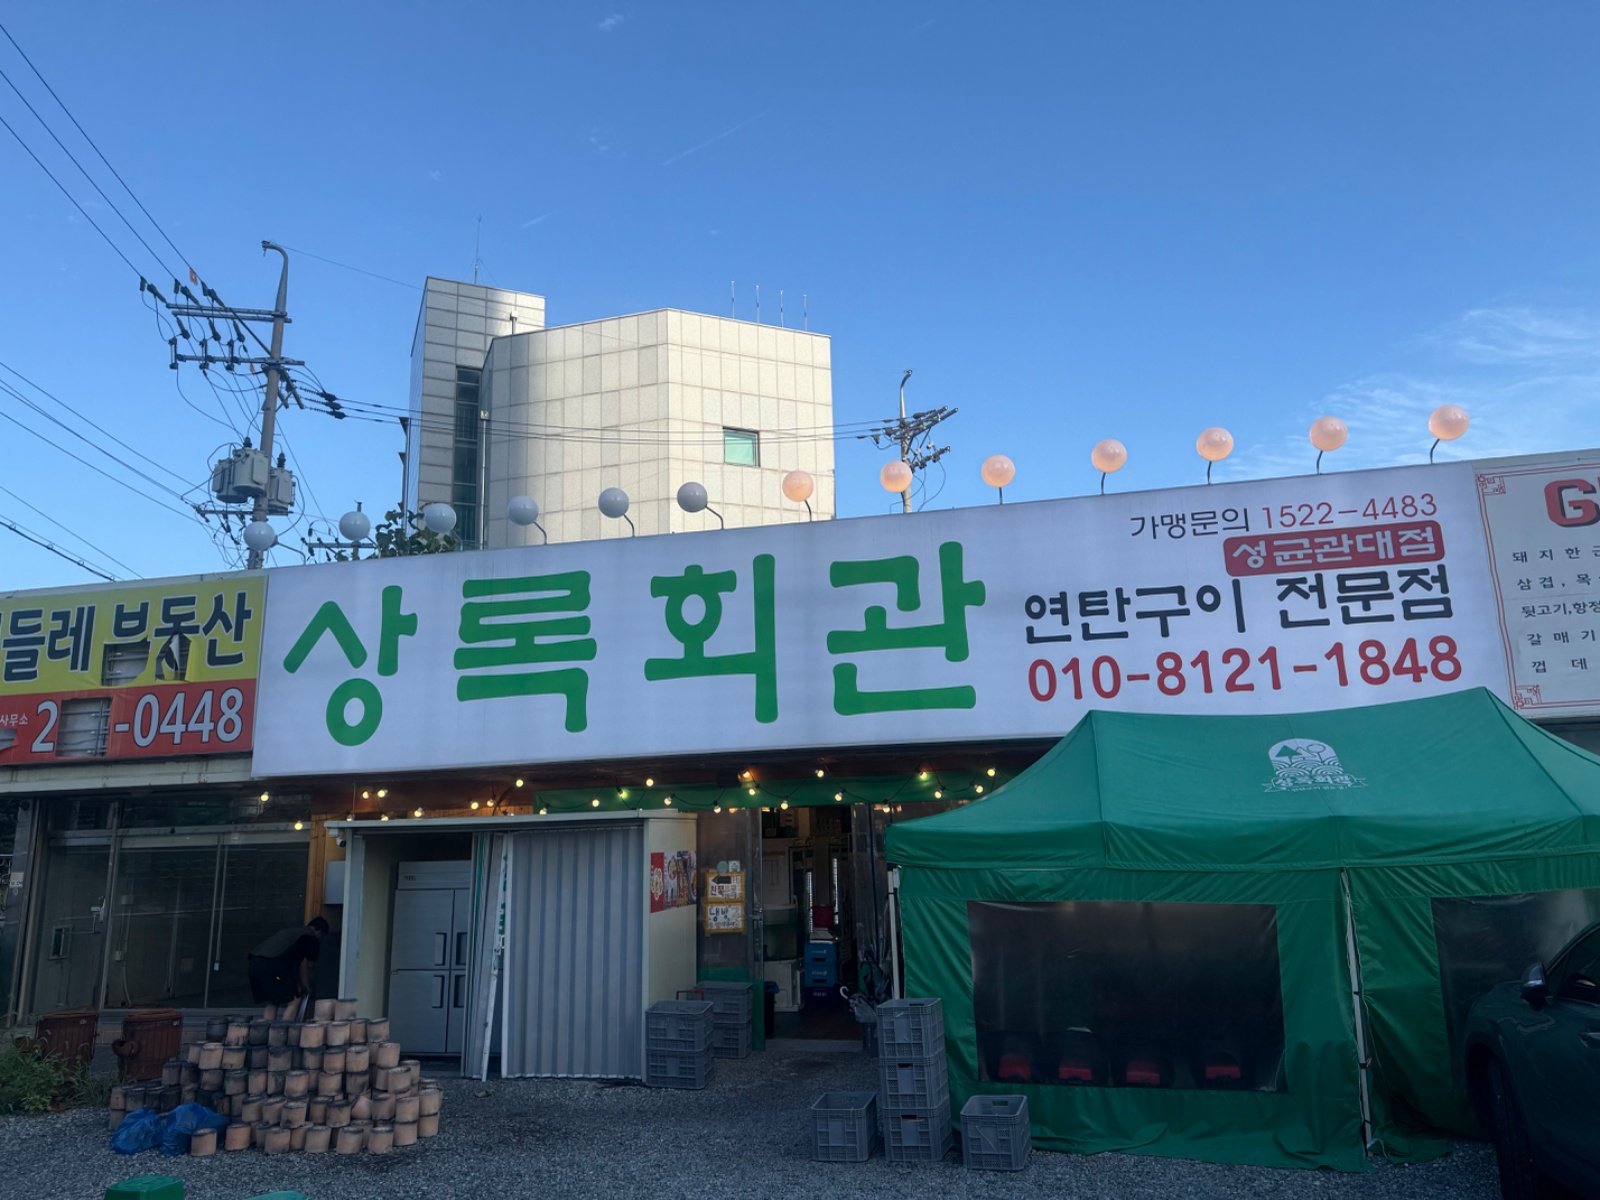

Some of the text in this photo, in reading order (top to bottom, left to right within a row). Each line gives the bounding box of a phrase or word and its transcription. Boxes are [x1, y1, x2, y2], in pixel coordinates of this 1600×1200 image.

[1130, 493, 1437, 541] 가맹문의 1522-4483
[1232, 527, 1437, 569] 성균관대점
[1024, 564, 1454, 645] 연탄구이 전문점
[0, 605, 97, 683] 들레
[283, 541, 987, 747] 상록회관
[1027, 635, 1463, 703] 010-8121-1848
